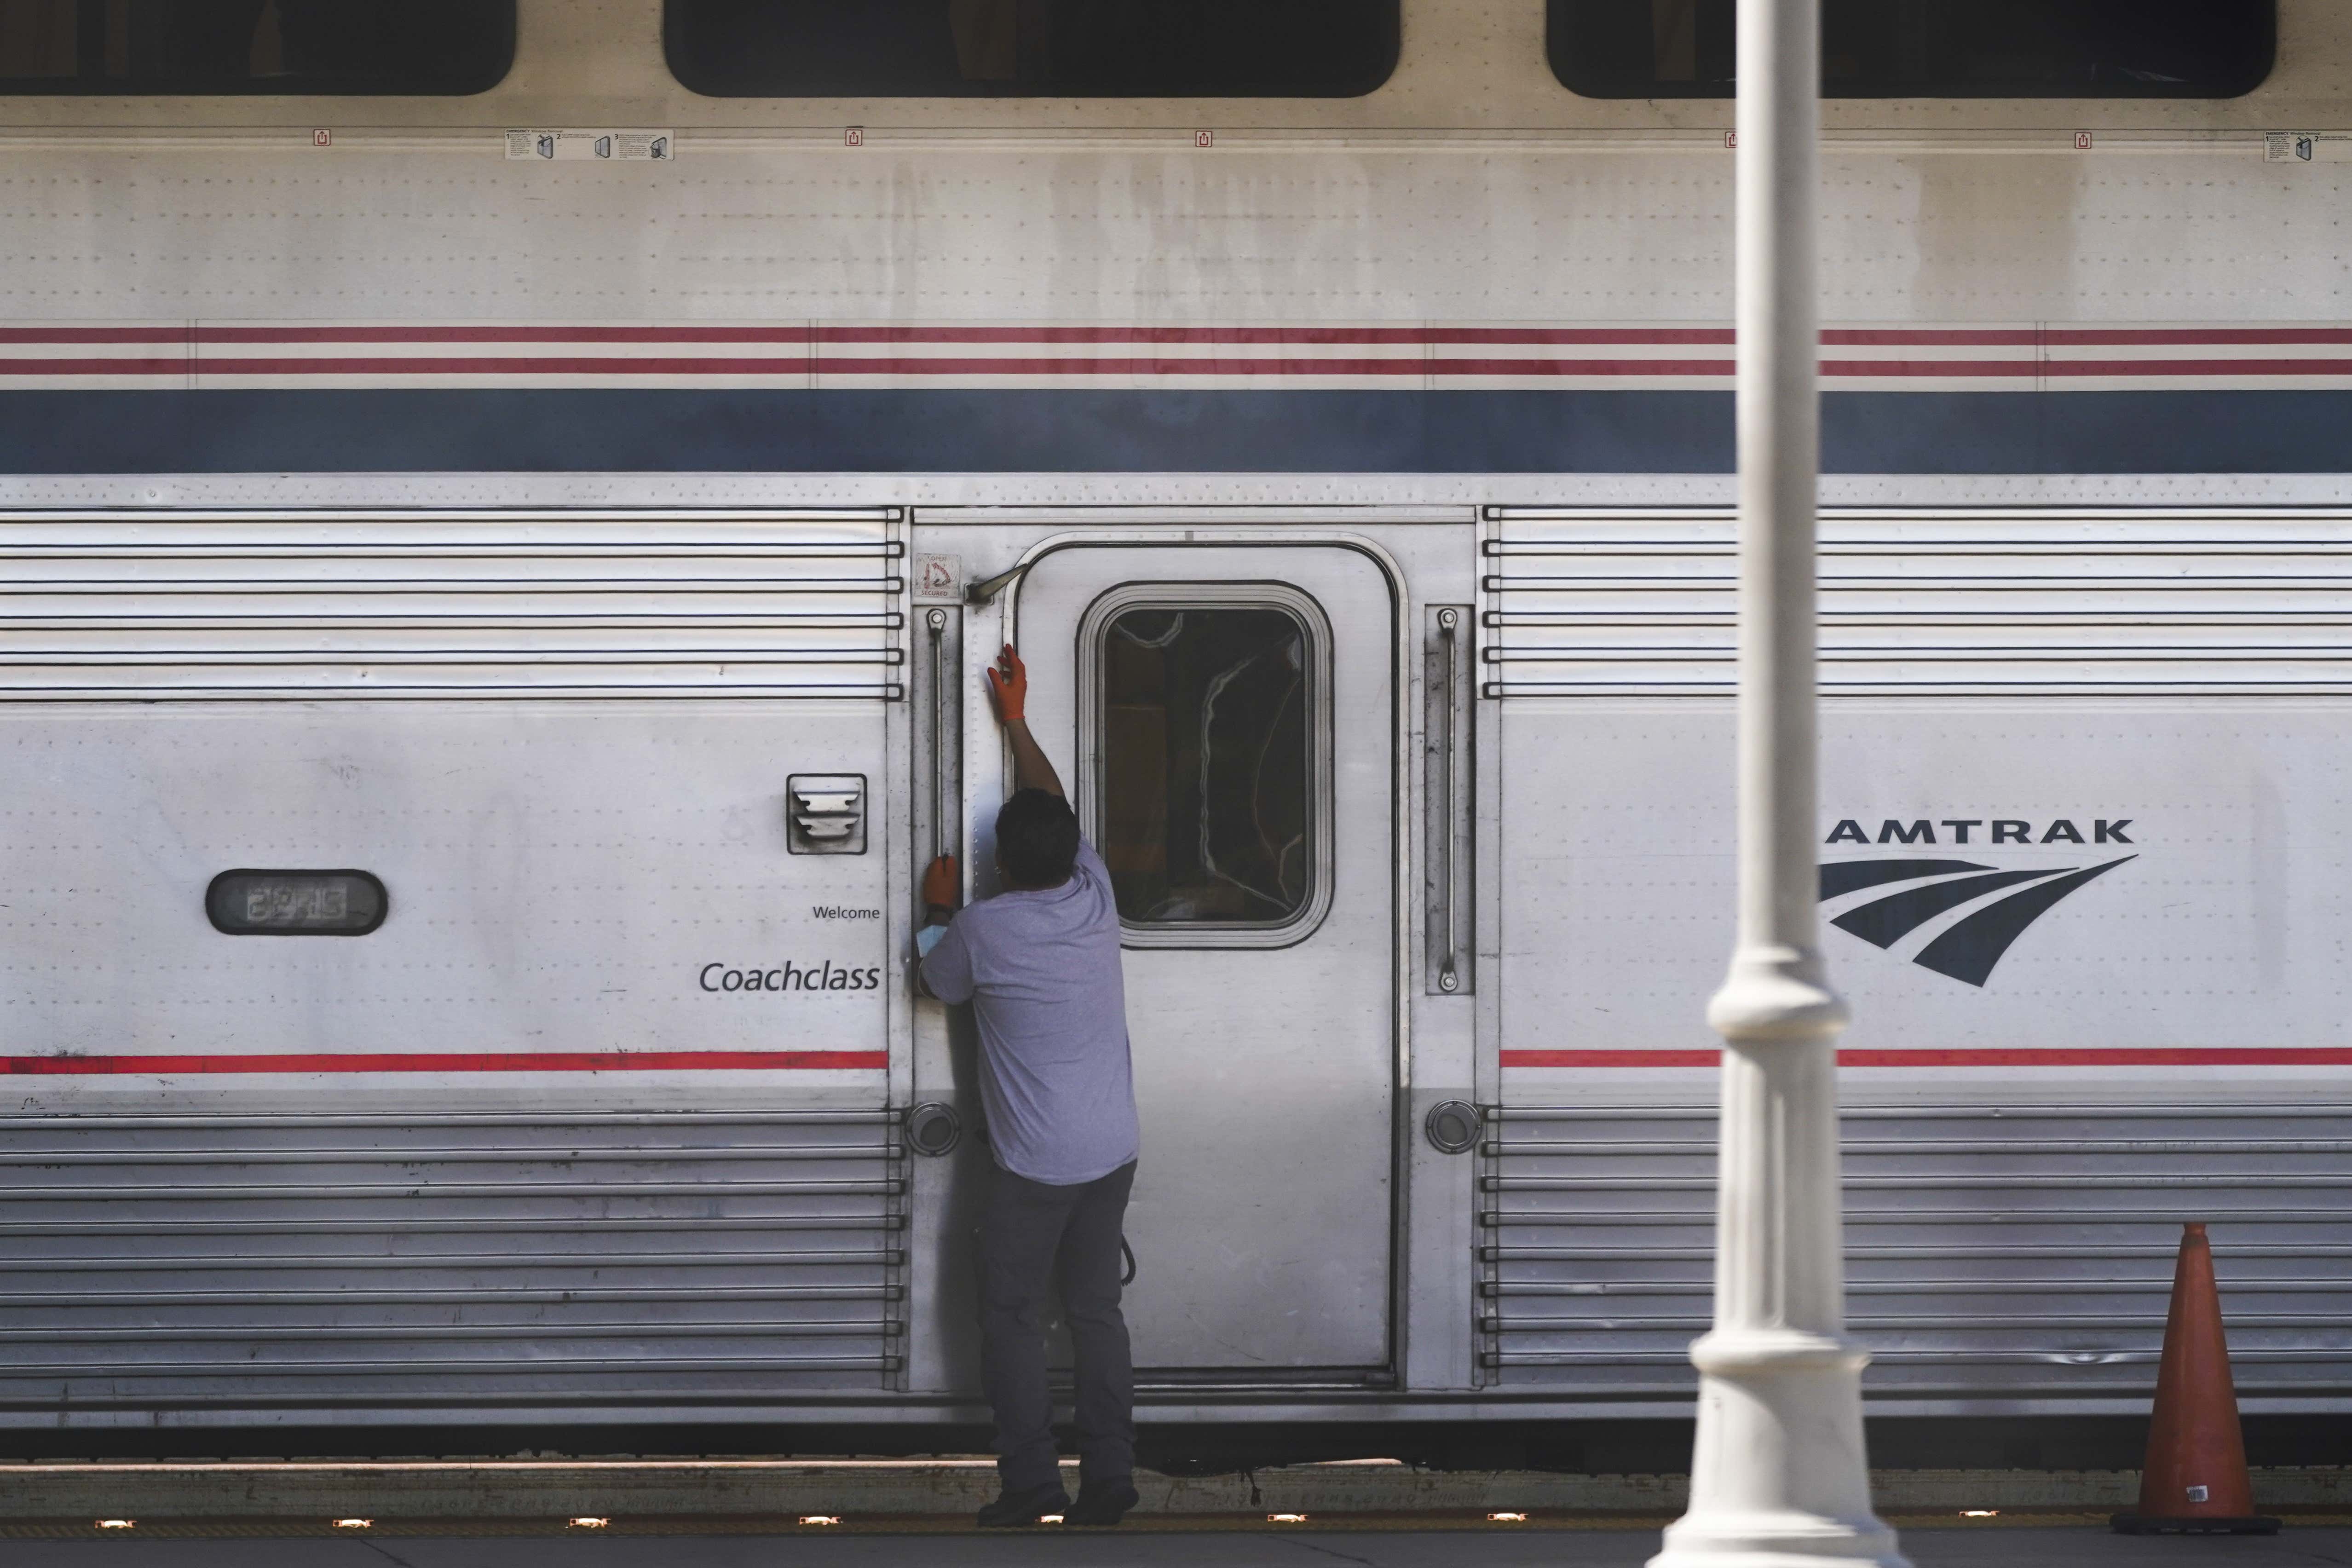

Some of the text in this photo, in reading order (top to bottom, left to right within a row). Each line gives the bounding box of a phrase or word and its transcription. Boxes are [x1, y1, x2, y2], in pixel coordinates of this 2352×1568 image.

[1825, 819, 2135, 844] AMTRAK
[813, 906, 880, 919] Welcome
[699, 960, 880, 992] Coachclass
